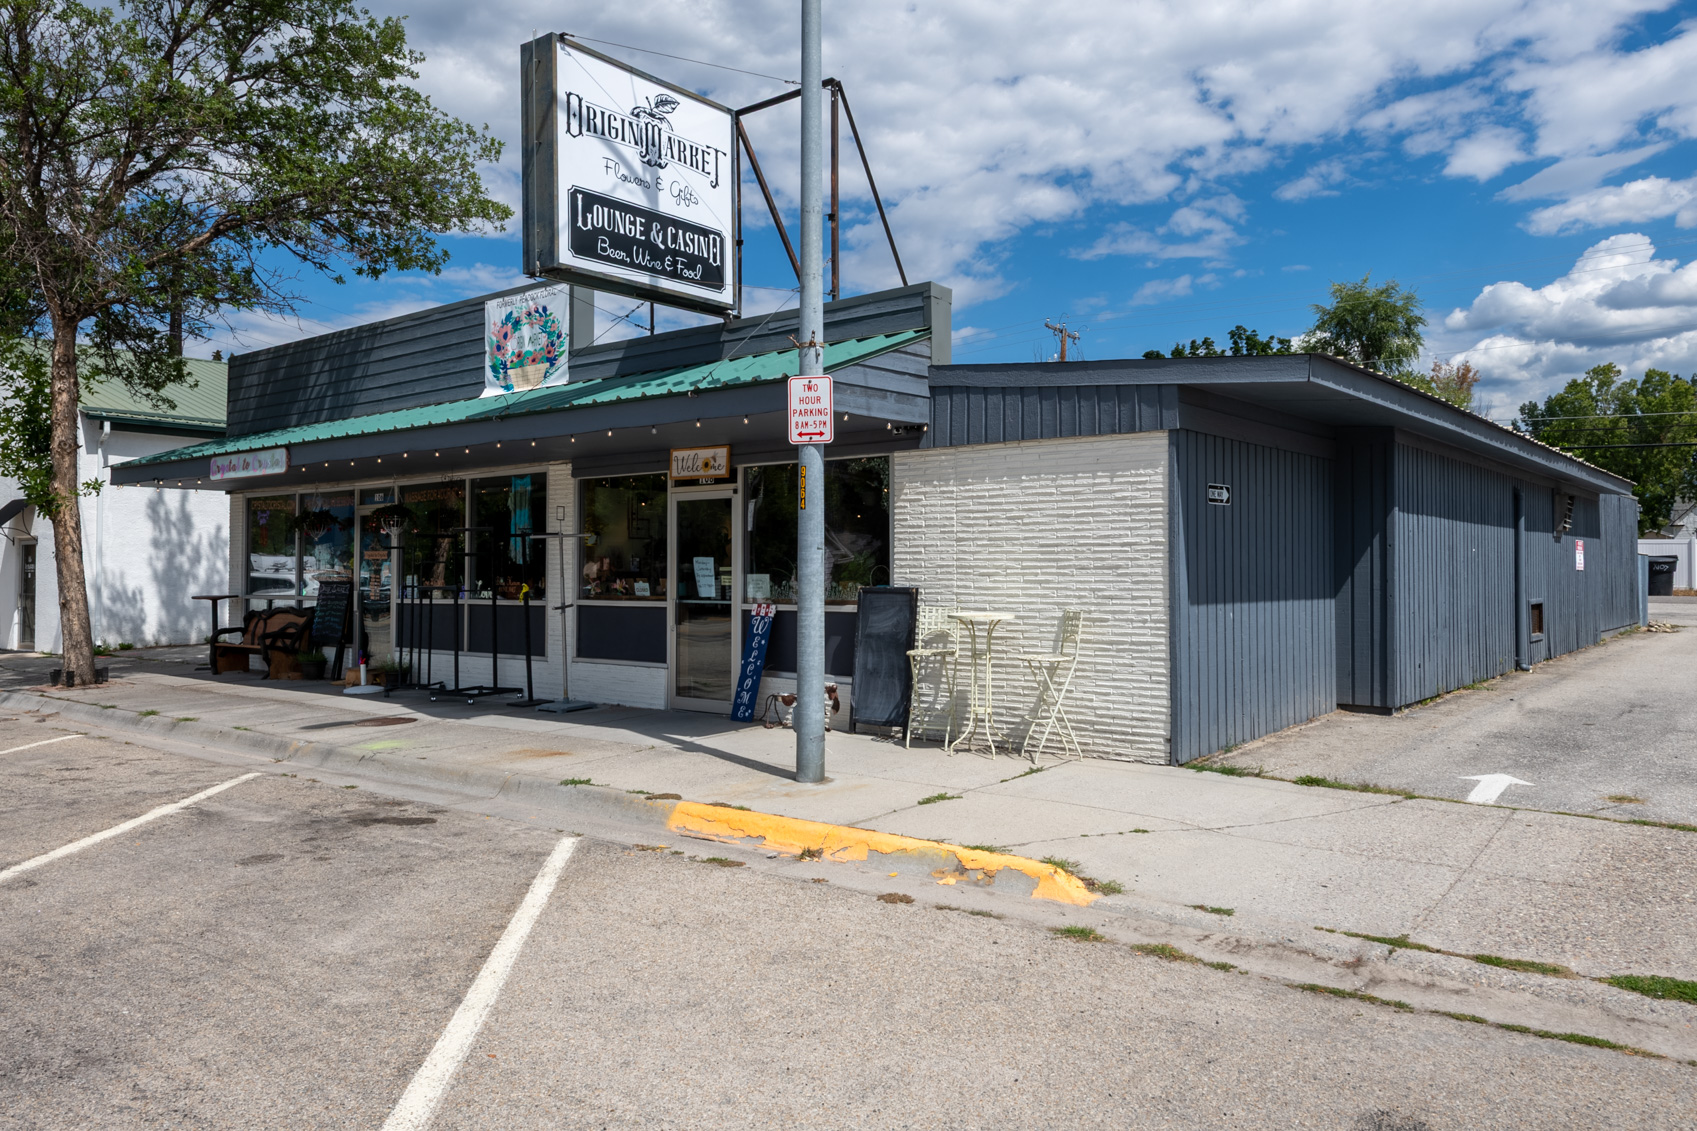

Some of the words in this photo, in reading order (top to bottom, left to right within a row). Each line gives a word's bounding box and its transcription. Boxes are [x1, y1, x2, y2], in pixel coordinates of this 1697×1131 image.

[565, 91, 641, 148] ORIGIN
[640, 121, 727, 189] MARKET
[602, 157, 651, 190] Flowers
[655, 175, 664, 192] &
[670, 180, 699, 207] Gifts
[577, 193, 646, 241] LOUNGE
[650, 222, 665, 250] &
[667, 226, 721, 267] CASINO
[598, 236, 630, 263] Beer,
[633, 245, 662, 270] Wine
[665, 255, 673, 271] &
[675, 257, 702, 280] Food
[497, 297, 517, 310] FORMERLY
[799, 396, 822, 405] HOUR
[802, 383, 819, 393] TWO
[792, 408, 829, 418] PARKING
[210, 456, 240, 478] Crystal
[242, 458, 250, 471] to
[252, 453, 283, 475] Crystal
[737, 616, 769, 718] WELCOME
